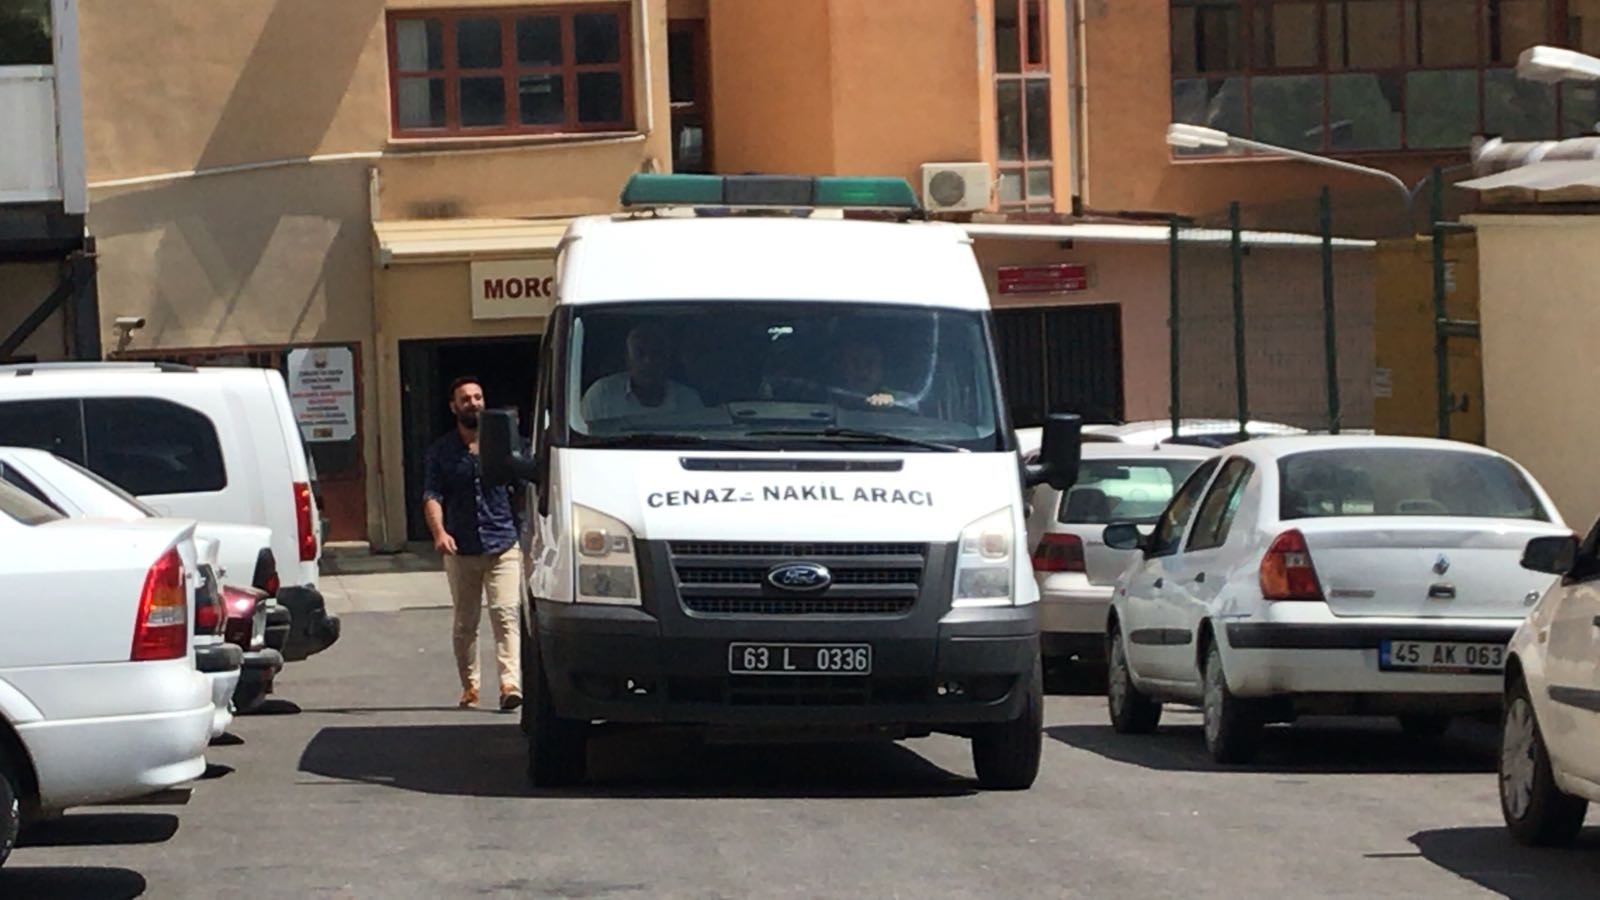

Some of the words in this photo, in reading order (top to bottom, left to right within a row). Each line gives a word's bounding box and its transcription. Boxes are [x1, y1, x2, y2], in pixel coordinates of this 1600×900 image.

[762, 481, 844, 501] NAKİL
[853, 487, 933, 507] ARACI
[743, 647, 769, 669] 63
[783, 648, 796, 670] L
[817, 648, 867, 670] 0336
[1395, 643, 1420, 663] 45
[1433, 645, 1457, 664] AK
